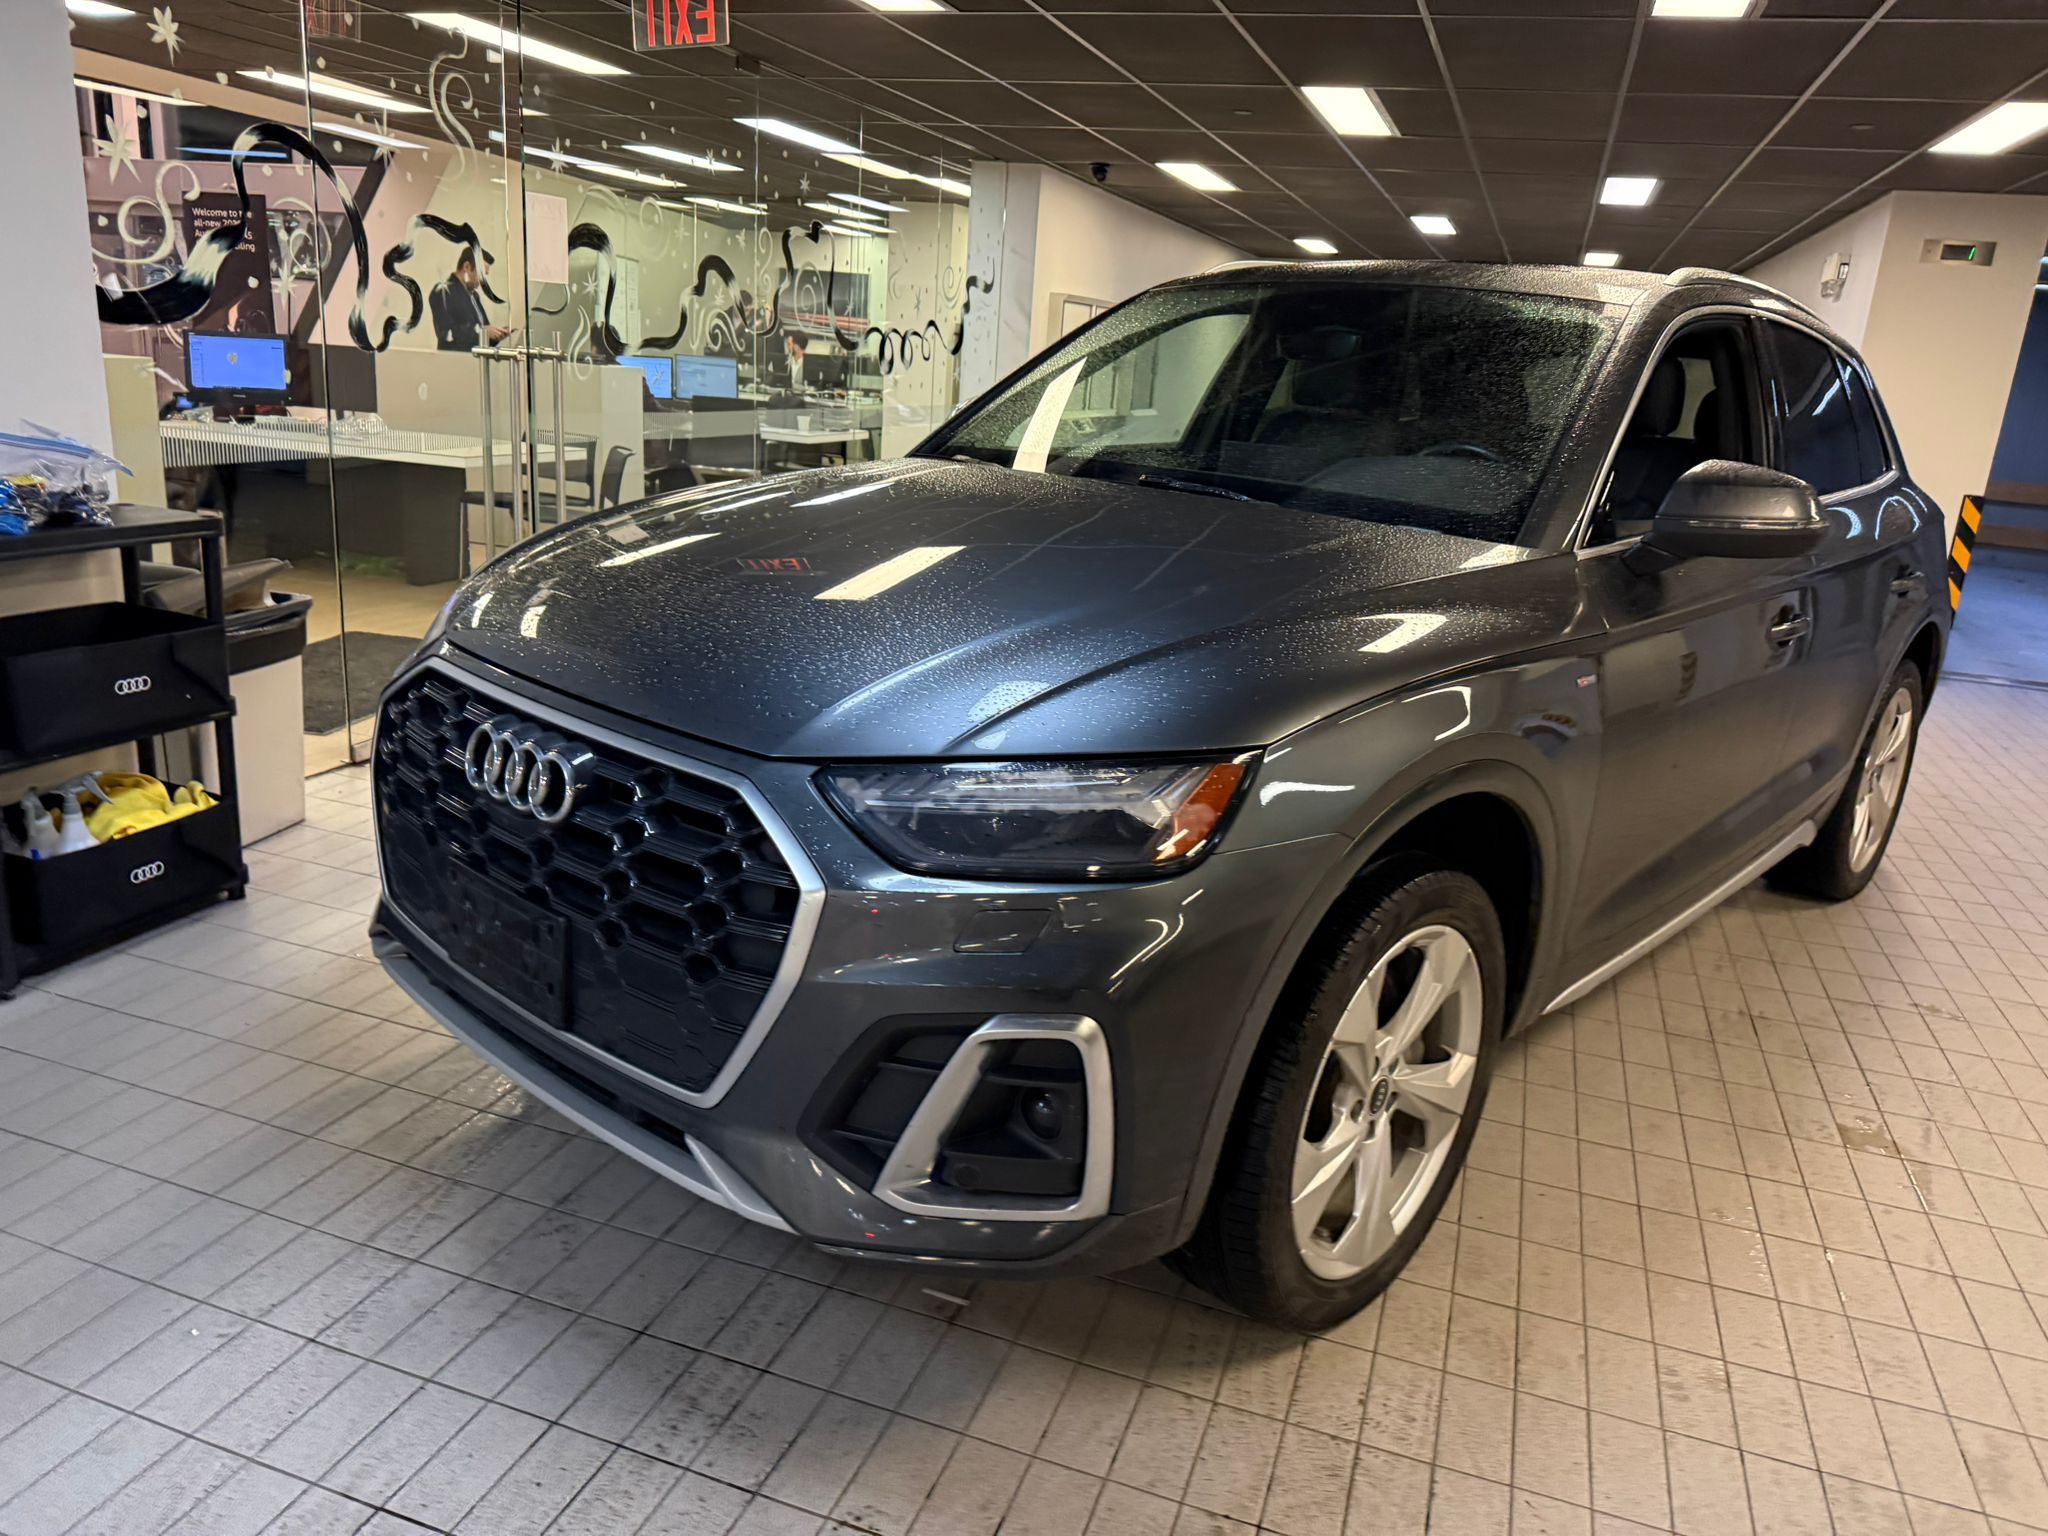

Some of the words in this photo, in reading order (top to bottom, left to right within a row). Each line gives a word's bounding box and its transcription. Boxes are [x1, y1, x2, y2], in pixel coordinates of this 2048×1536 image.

[192, 207, 228, 217] Welcome
[229, 209, 238, 218] to
[239, 210, 252, 219] te
[193, 218, 221, 228] all-new
